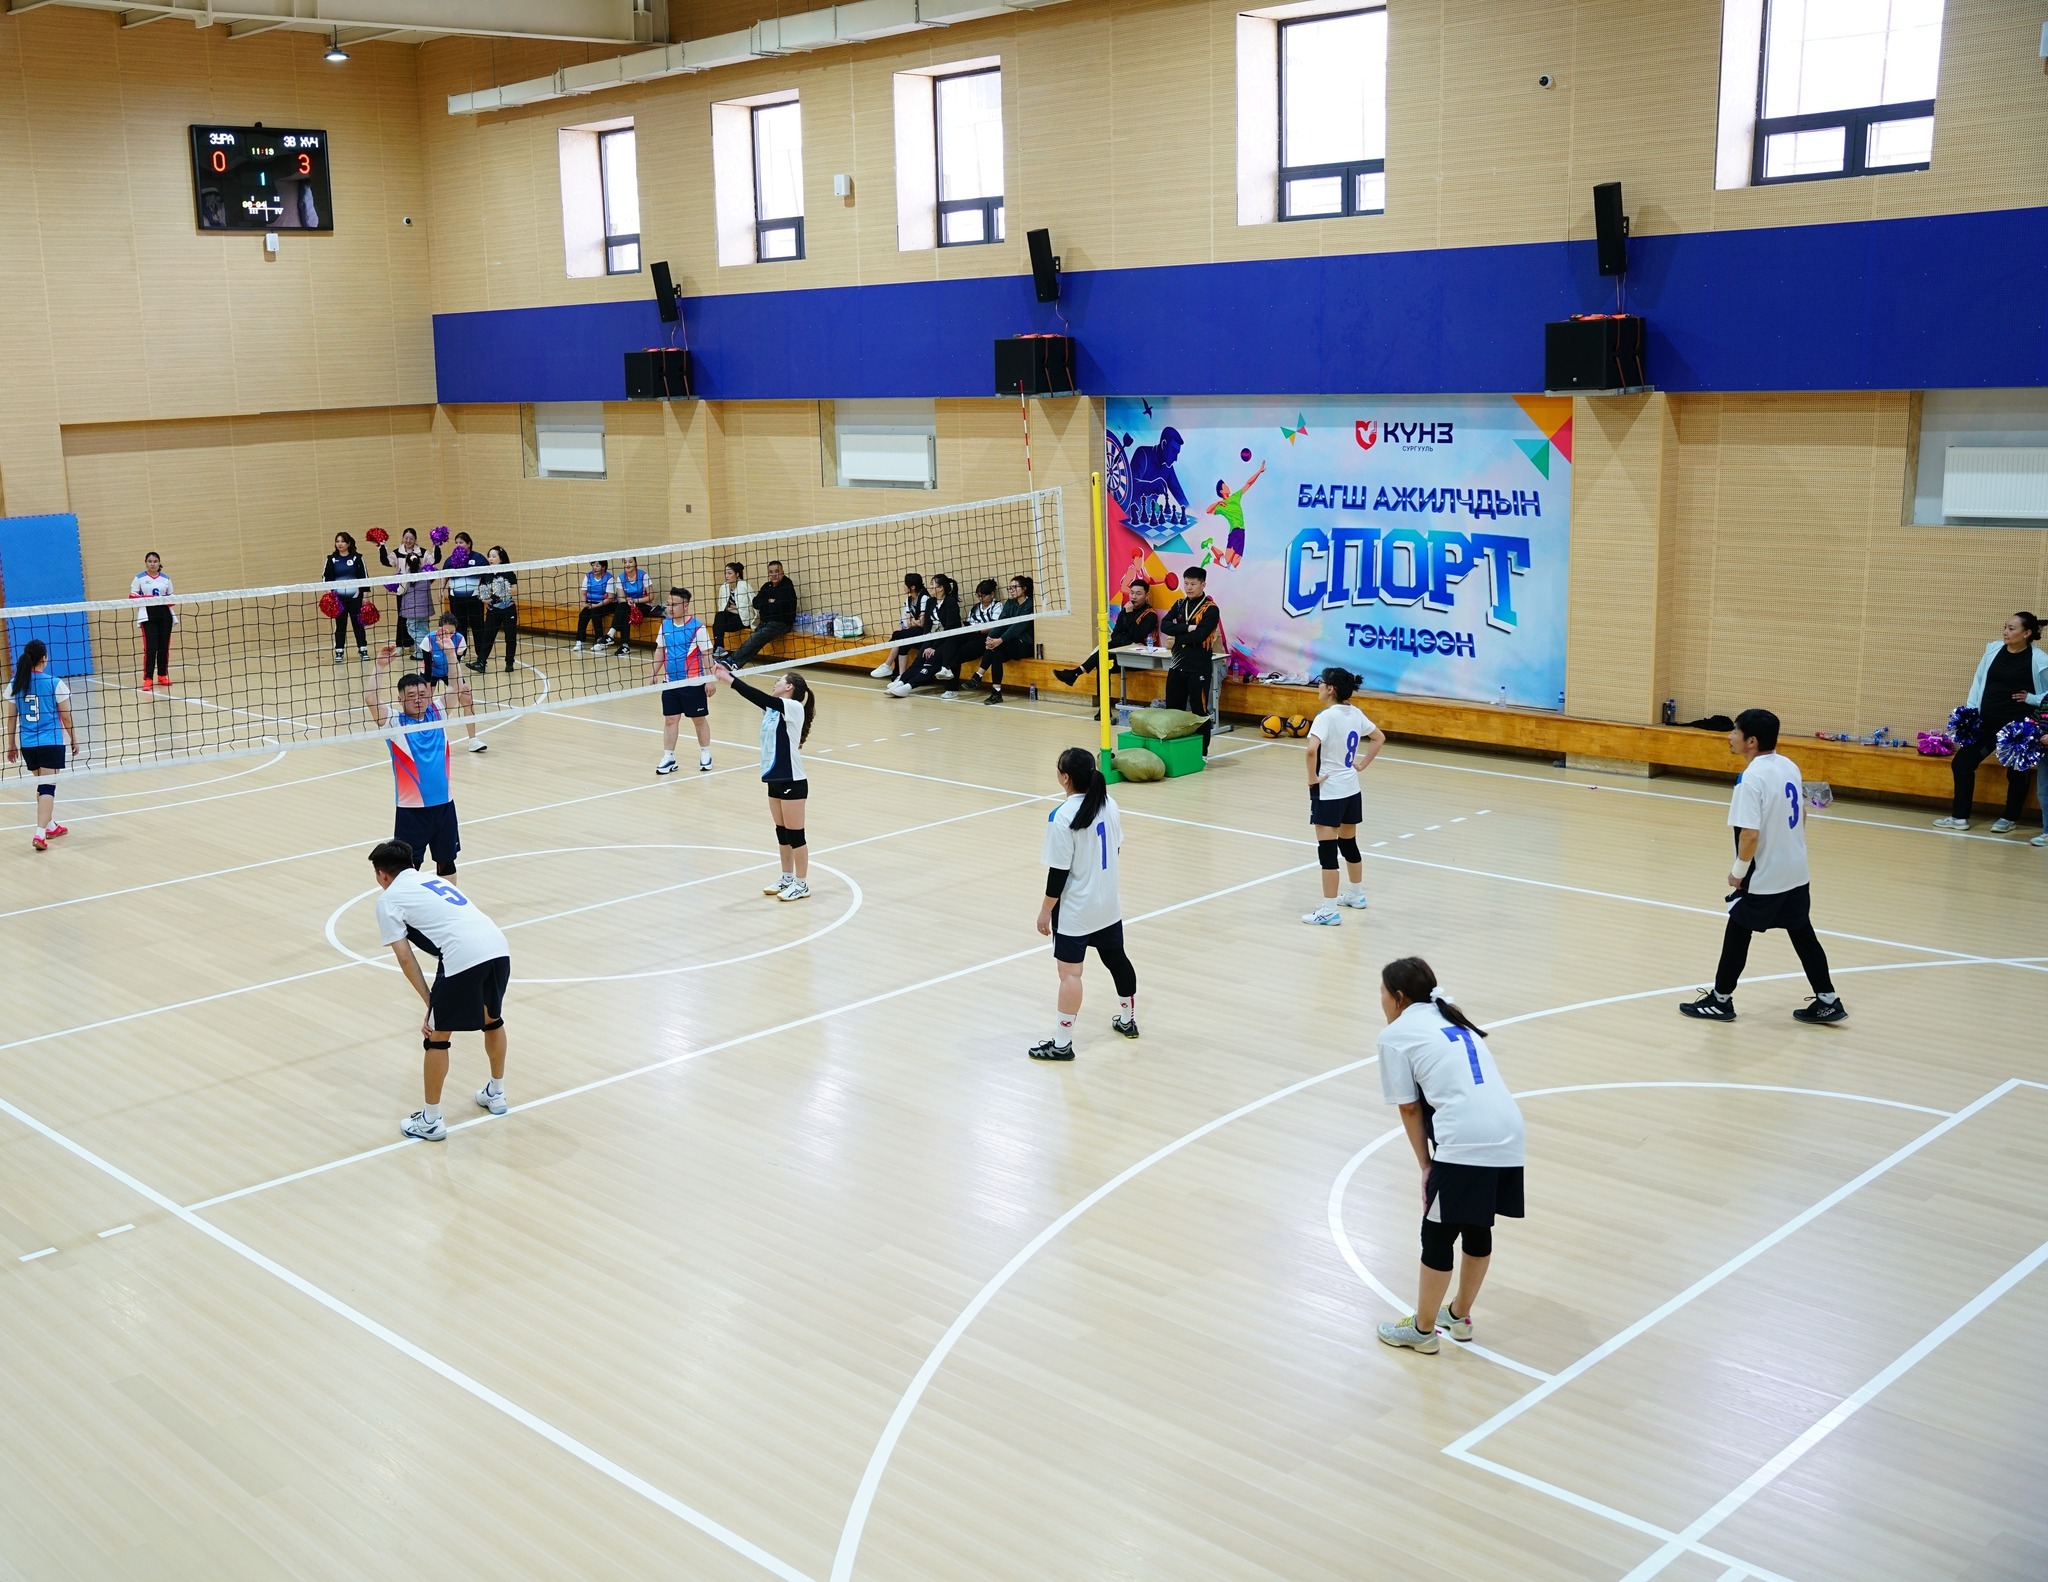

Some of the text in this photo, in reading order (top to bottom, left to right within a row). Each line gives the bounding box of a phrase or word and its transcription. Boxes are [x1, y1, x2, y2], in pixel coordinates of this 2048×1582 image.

[212, 151, 227, 172] 0
[260, 172, 267, 186] 1
[298, 153, 311, 175] 3
[1383, 422, 1454, 444] КҮНЗ
[1298, 483, 1541, 520] БАГШ АЖИЛЧДЫН
[1284, 528, 1531, 633] СПОРТ
[1345, 622, 1476, 658] ТЭМЦЭЭН
[24, 695, 40, 722] 3
[1344, 730, 1360, 768] 8
[1785, 782, 1800, 829] 3
[1097, 821, 1107, 870] 1
[421, 880, 468, 906] 5
[1441, 1025, 1485, 1085] 7
